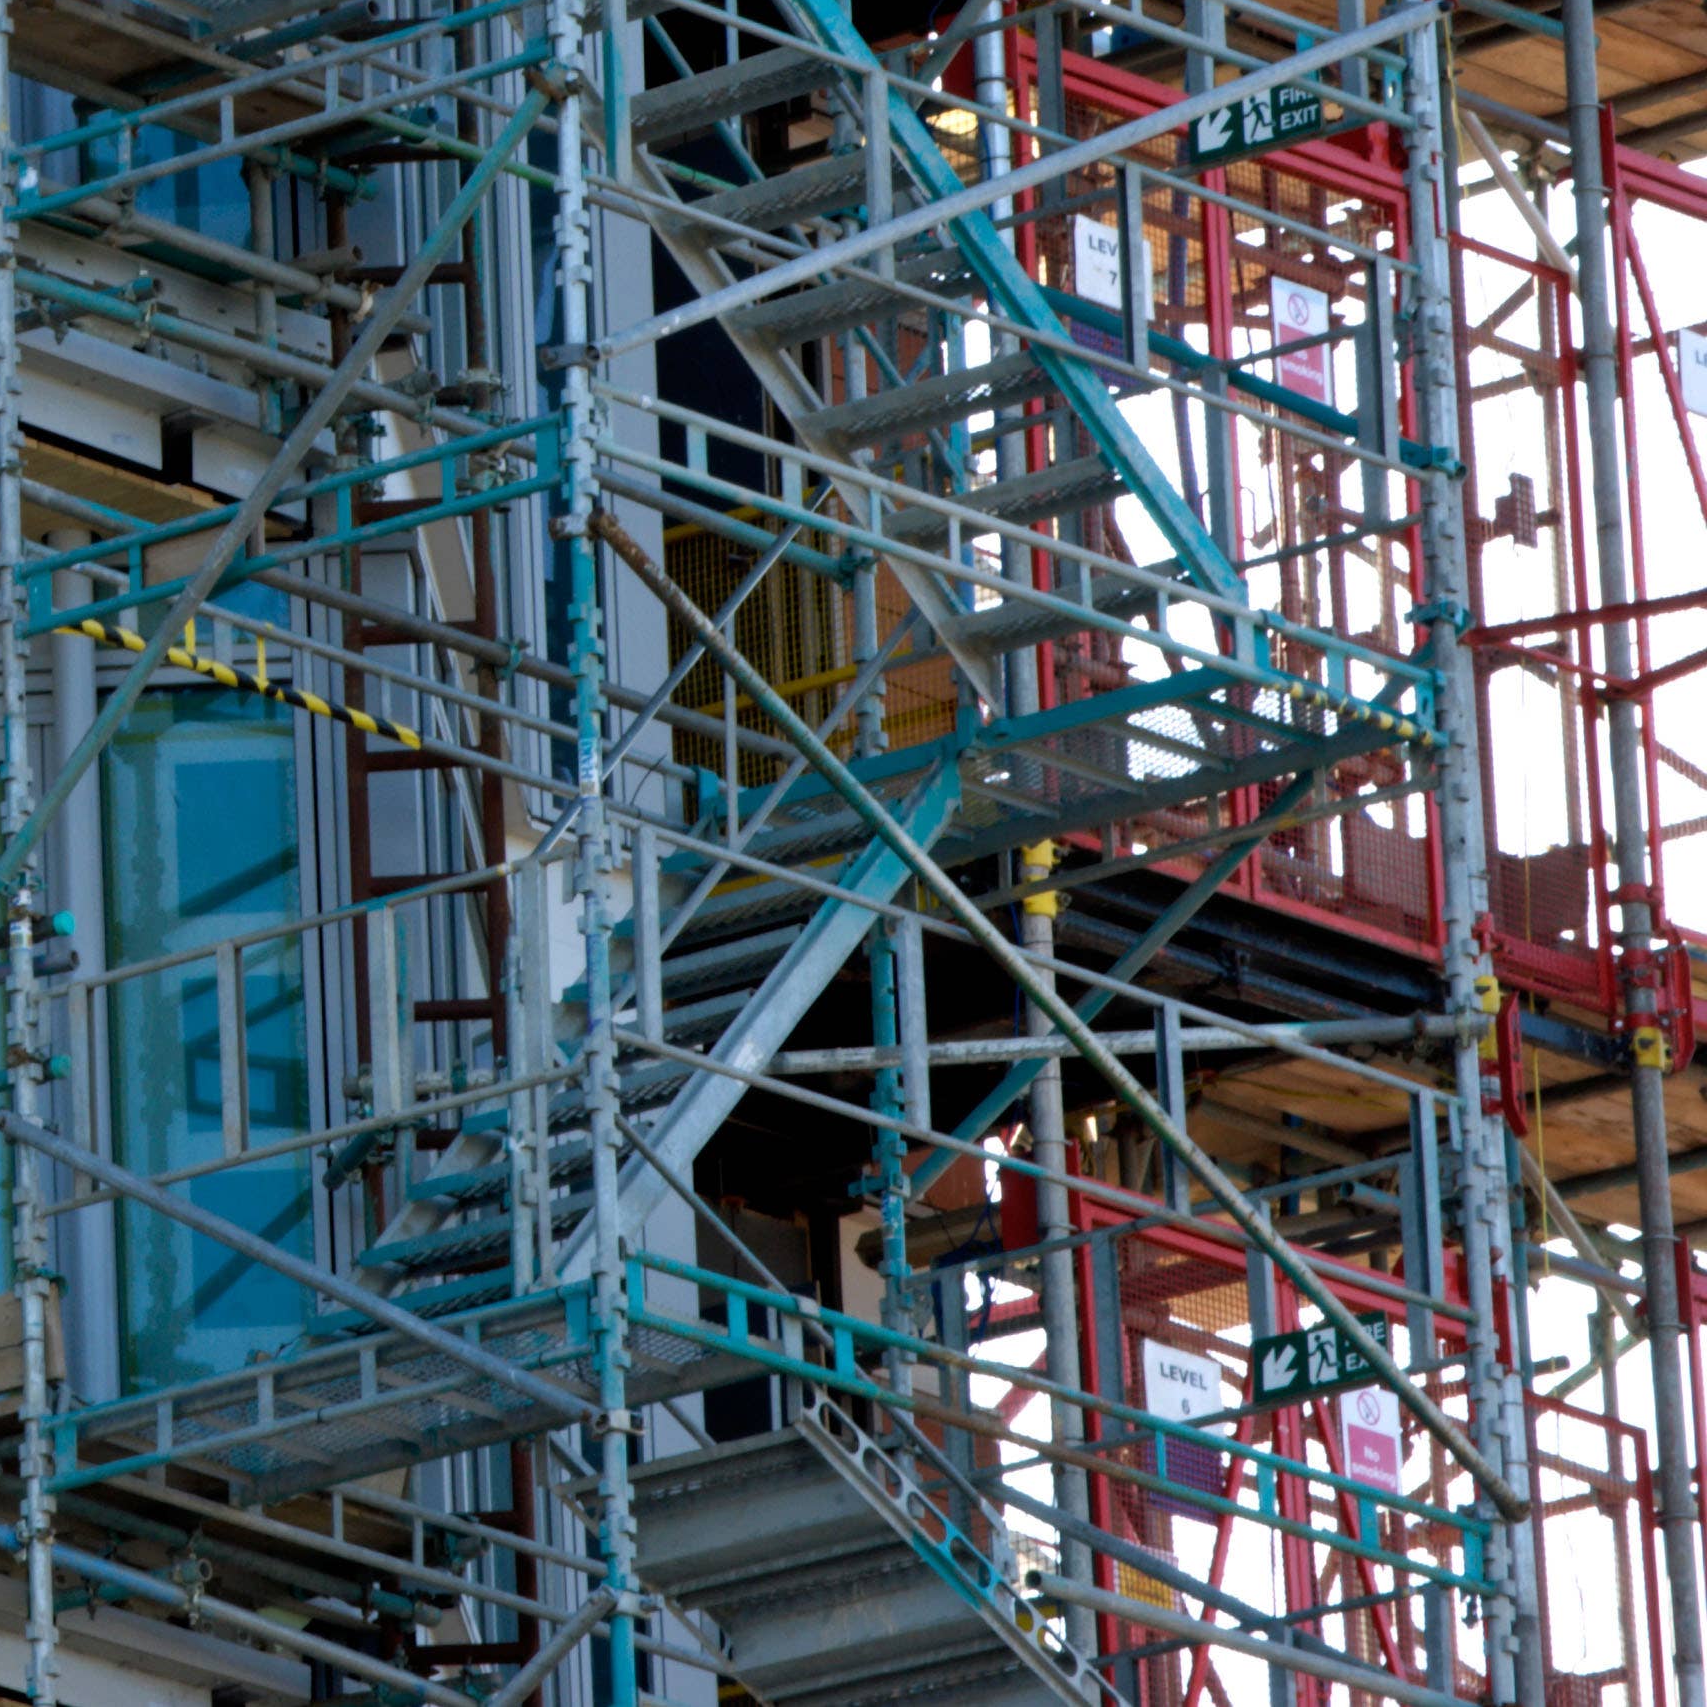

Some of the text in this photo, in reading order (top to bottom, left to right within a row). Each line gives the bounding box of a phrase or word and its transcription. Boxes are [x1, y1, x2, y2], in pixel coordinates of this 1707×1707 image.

[1279, 103, 1320, 131] EXIT
[1088, 234, 1119, 257] LEV
[1108, 269, 1118, 286] 7
[1159, 1361, 1208, 1392] LEVEL
[1181, 1397, 1191, 1416] 6
[1362, 1445, 1380, 1463] No
[1350, 1462, 1396, 1488] smoking
